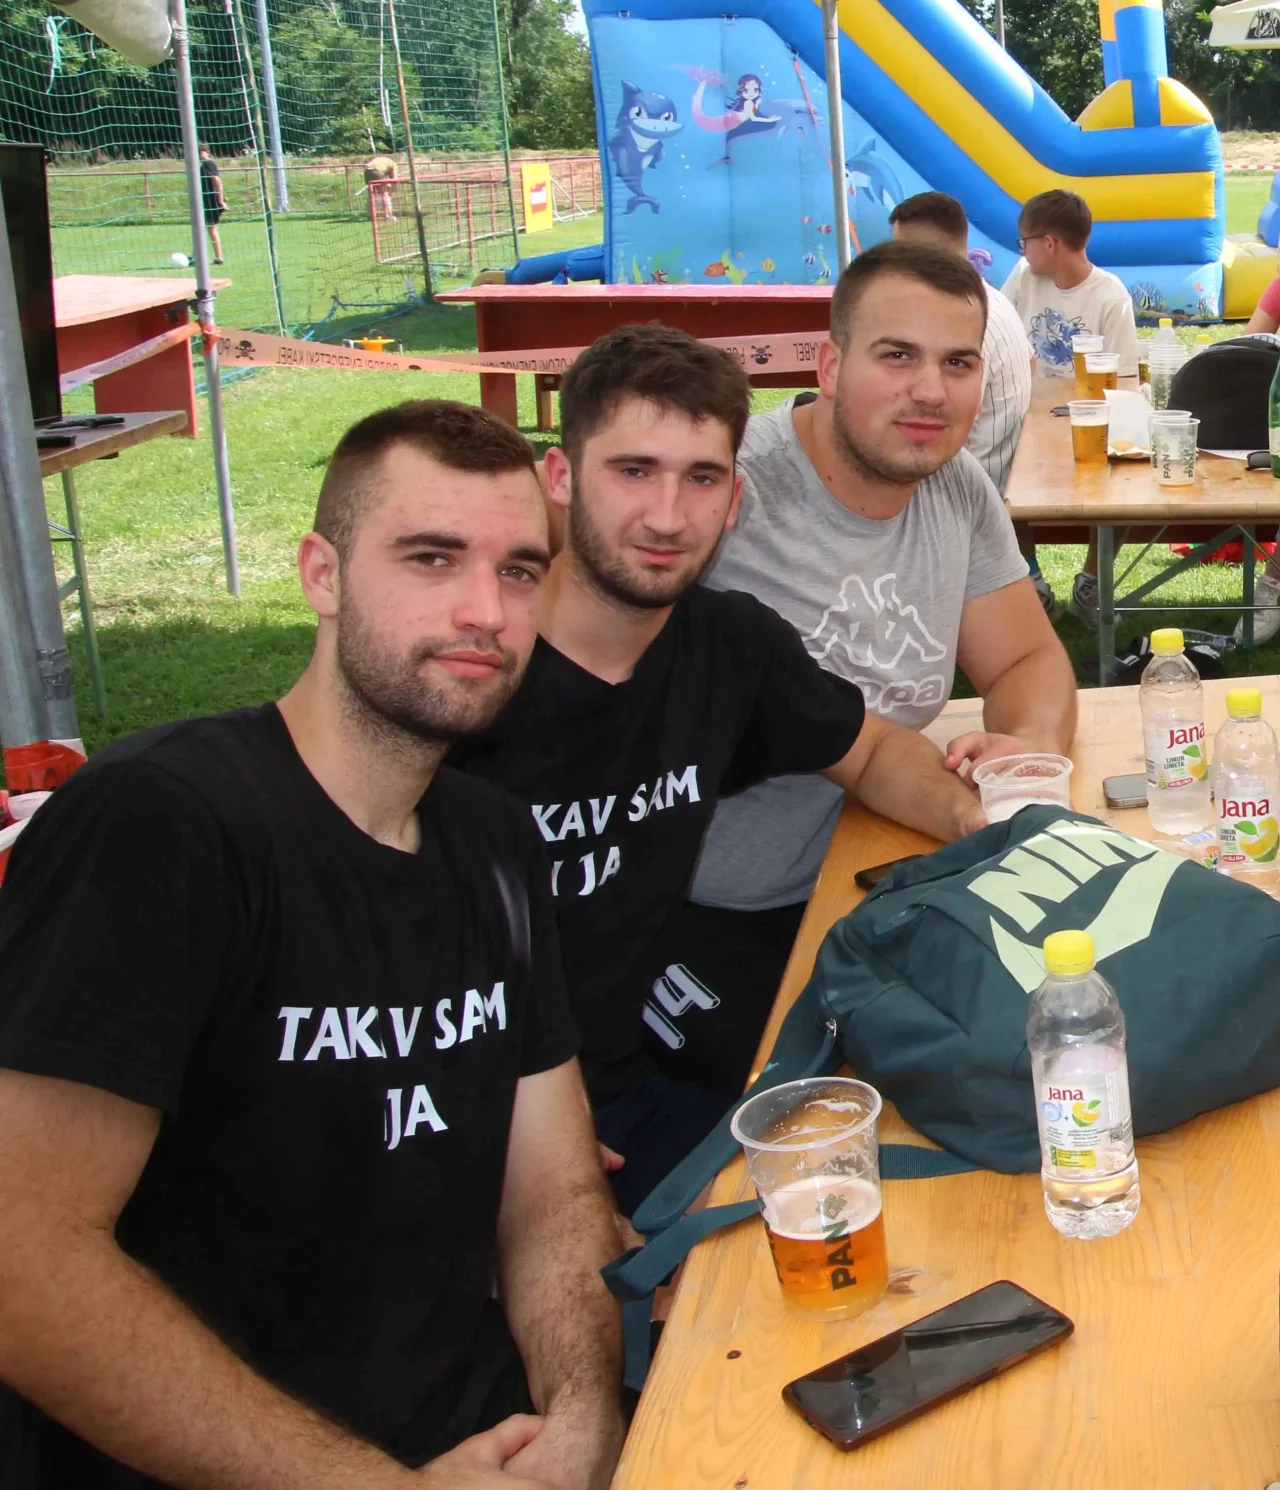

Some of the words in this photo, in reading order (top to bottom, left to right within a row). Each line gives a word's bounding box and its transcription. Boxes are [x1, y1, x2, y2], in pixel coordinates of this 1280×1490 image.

[1163, 454, 1171, 479] PAN
[1166, 756, 1185, 764] LIMUN
[1167, 722, 1205, 749] Jana
[531, 795, 617, 842] KAV
[628, 765, 701, 822] SAM
[1220, 798, 1270, 818] Jana
[578, 846, 621, 896] JA
[967, 819, 1160, 933] NIK
[277, 1005, 423, 1061] TAKV
[434, 981, 507, 1050] SAM
[642, 963, 721, 1050] 14
[387, 1084, 449, 1150] JA
[1048, 1087, 1084, 1101] Jana
[822, 1220, 857, 1291] PAN
